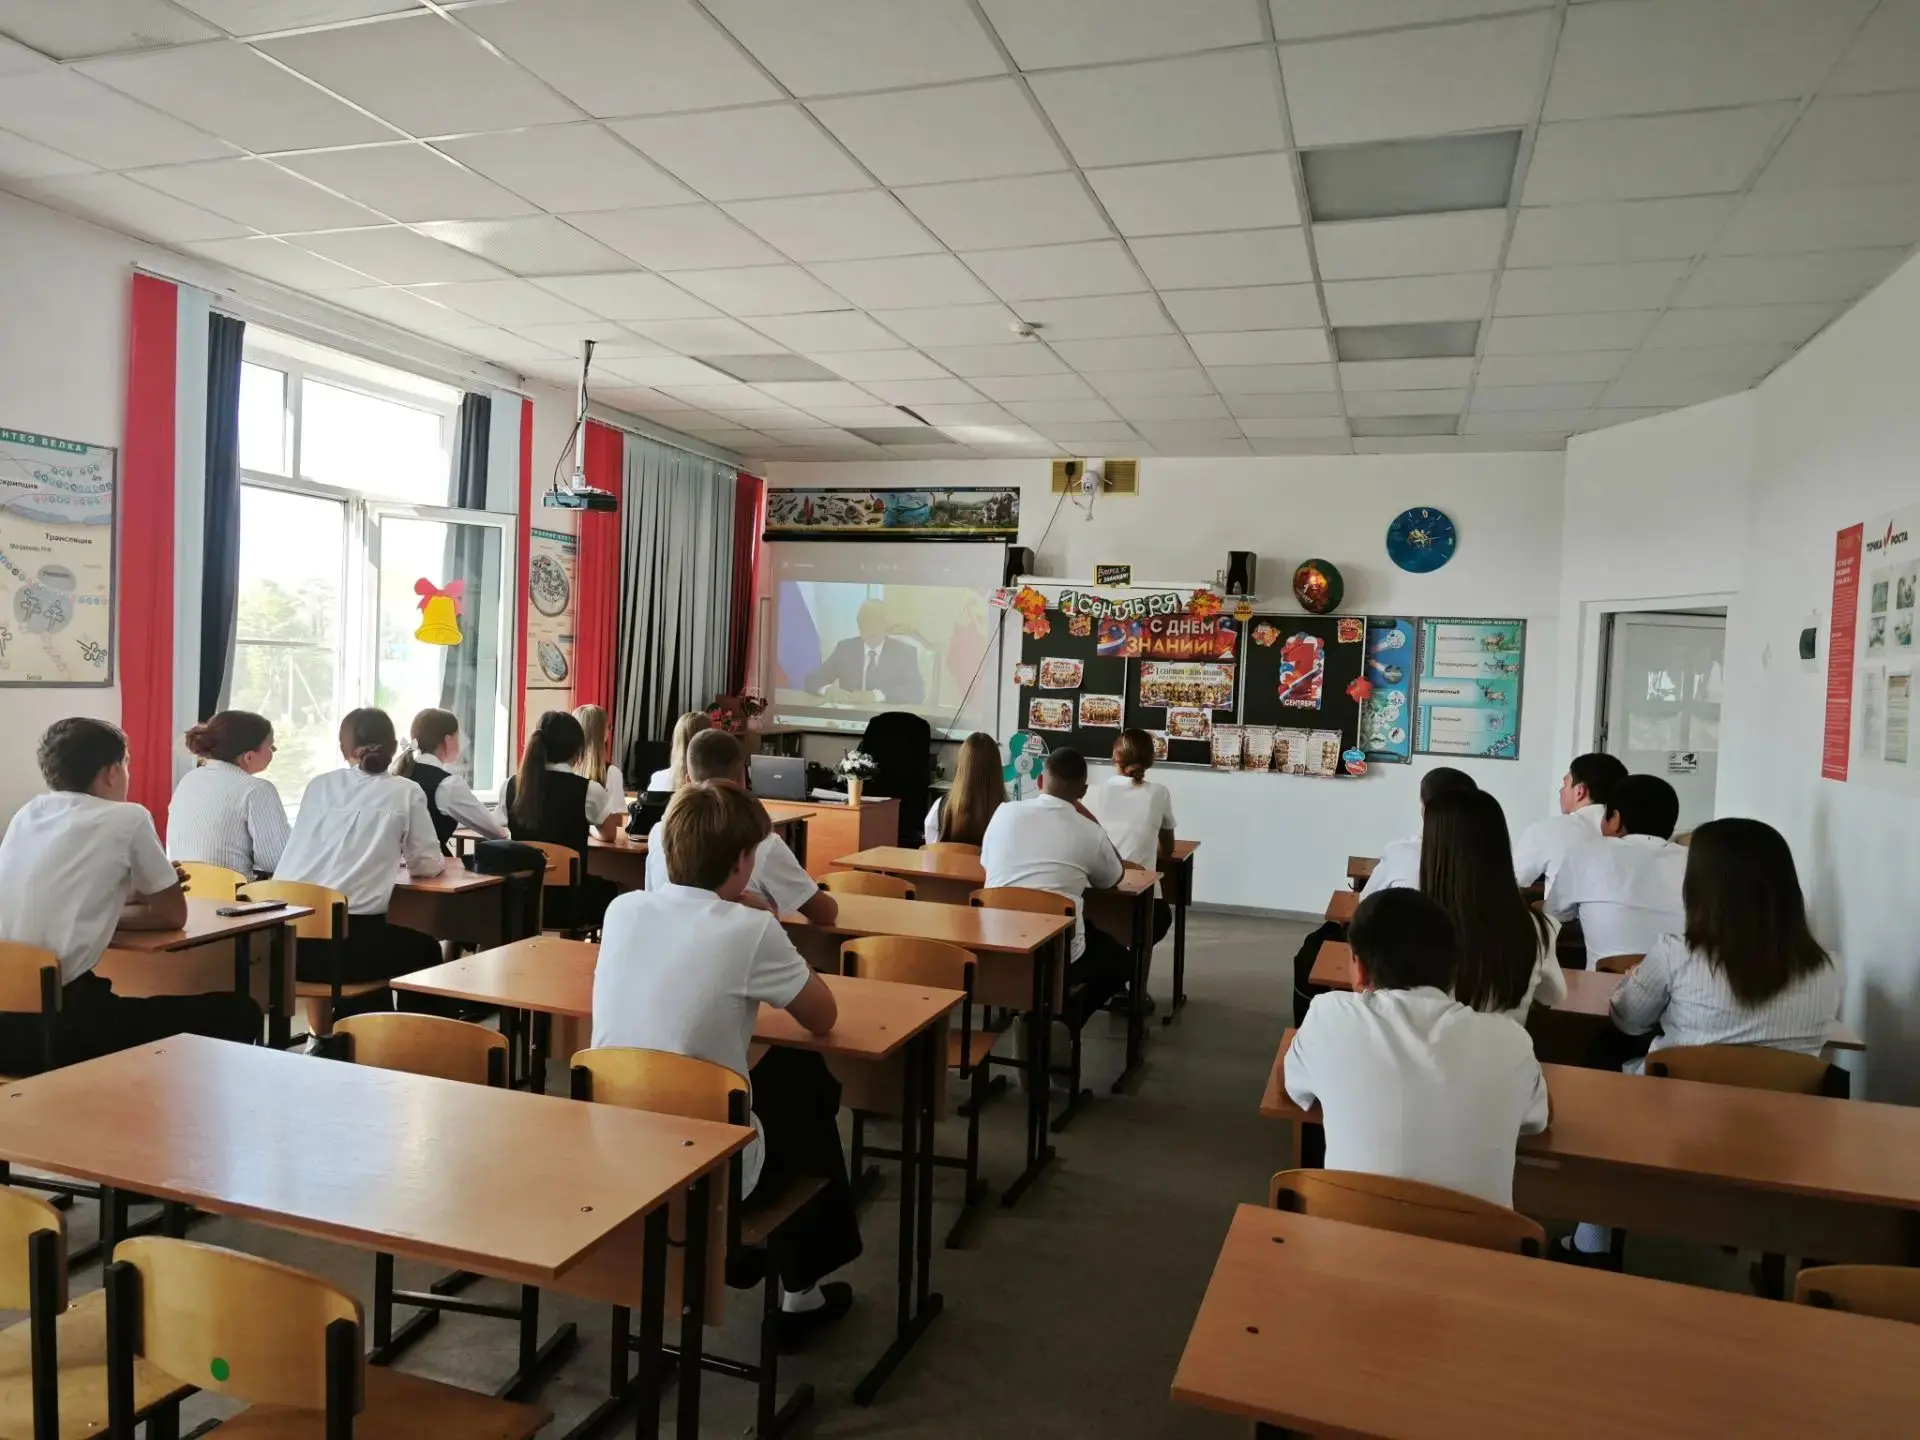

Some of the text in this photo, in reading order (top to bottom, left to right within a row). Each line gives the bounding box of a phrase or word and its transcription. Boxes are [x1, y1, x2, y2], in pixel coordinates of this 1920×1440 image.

[42, 438, 82, 451] БЕЛКА
[45, 533, 92, 544] Трансляция
[1891, 530, 1908, 545] РОСТА
[1060, 591, 1077, 616] 1
[1150, 620, 1214, 637] С ДНЕМ
[1126, 637, 1214, 655] ЗНАНИЙ!
[1284, 699, 1317, 708] СЕНТЯБРЯ
